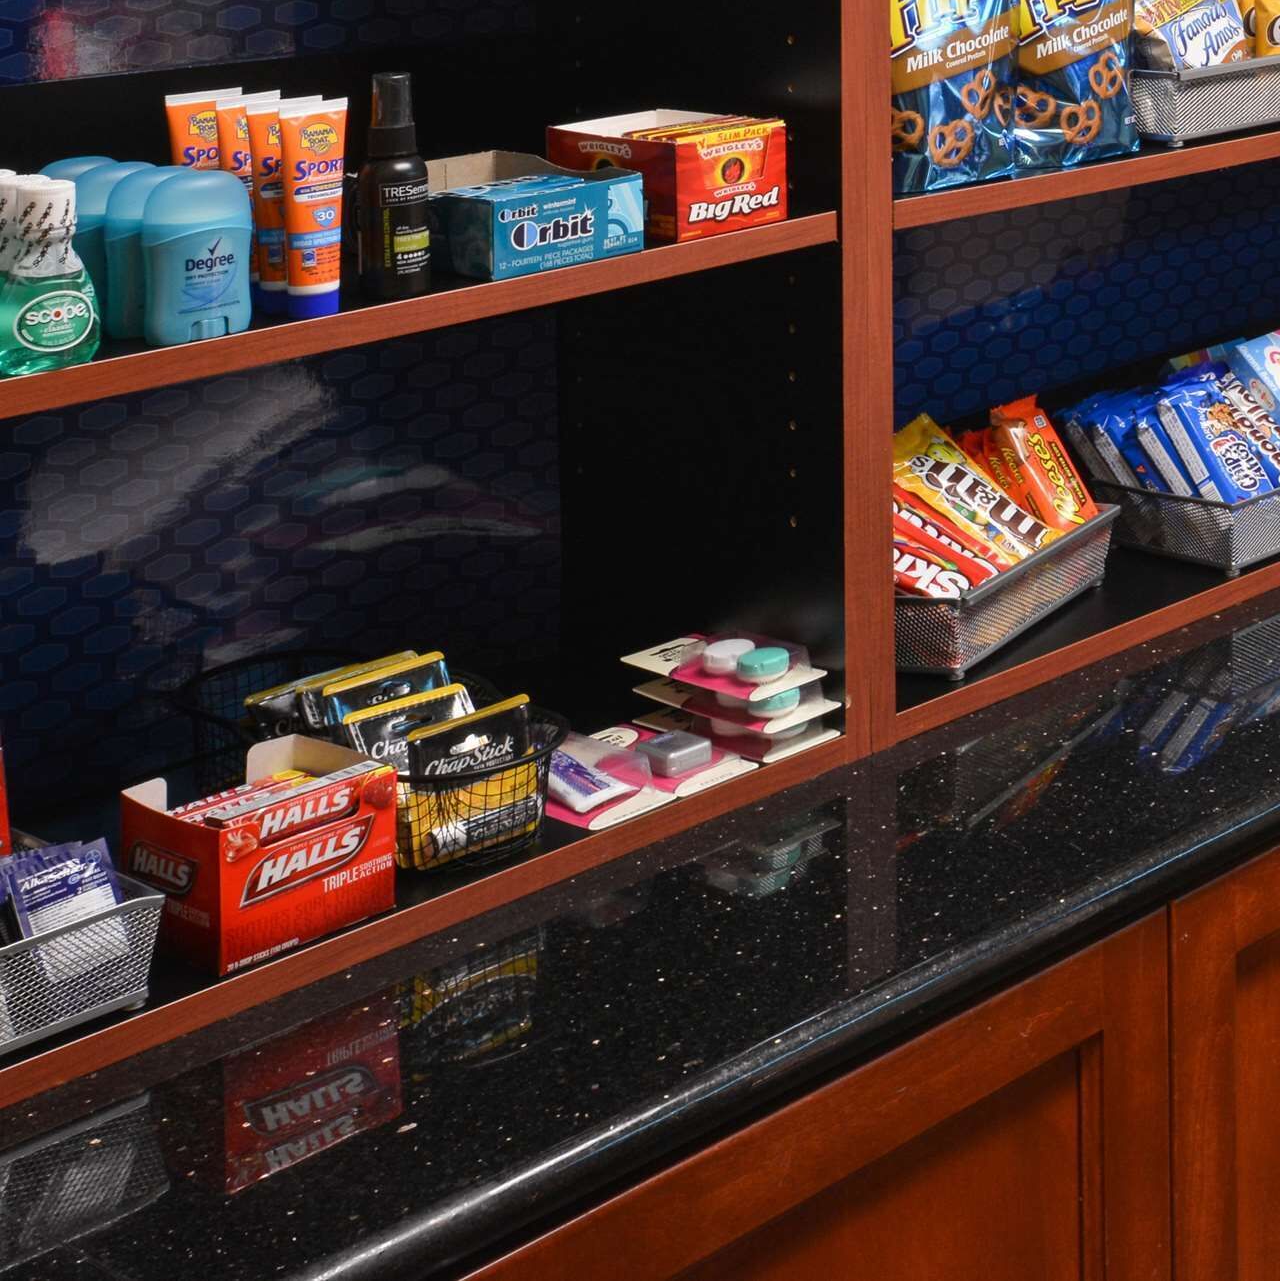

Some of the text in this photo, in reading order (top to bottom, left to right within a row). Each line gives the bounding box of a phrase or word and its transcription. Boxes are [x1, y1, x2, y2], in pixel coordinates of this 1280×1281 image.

[1036, 8, 1128, 59] Milk Chocolate
[1169, 3, 1227, 58] Famous
[906, 25, 1010, 73] Milk Chocolate
[1200, 22, 1241, 67] Amos
[308, 137, 330, 149] BOAT
[717, 126, 770, 144] SLIM PACK
[578, 140, 632, 159] WRIGLEY'S
[701, 139, 764, 160] WRIGLEY'S
[294, 157, 344, 182] SPORT
[498, 205, 538, 223] Orbit
[543, 198, 577, 209] wintermint
[733, 186, 780, 214] Red
[316, 210, 336, 221] 30
[510, 212, 594, 251] Orbit
[185, 253, 236, 272] Degree
[512, 255, 543, 268] FOURTEEN
[544, 251, 562, 261] PIECE
[562, 245, 594, 257] PACKAGES
[25, 303, 87, 326] scope
[911, 454, 1050, 553] m&m's
[424, 734, 514, 776] ChapStick
[259, 786, 353, 838] HALLS
[132, 847, 190, 888] HALLS
[255, 825, 365, 894] HALLS
[358, 853, 393, 871] SOOTHING
[360, 861, 393, 879] ACTION
[322, 868, 359, 894] TRIPLE
